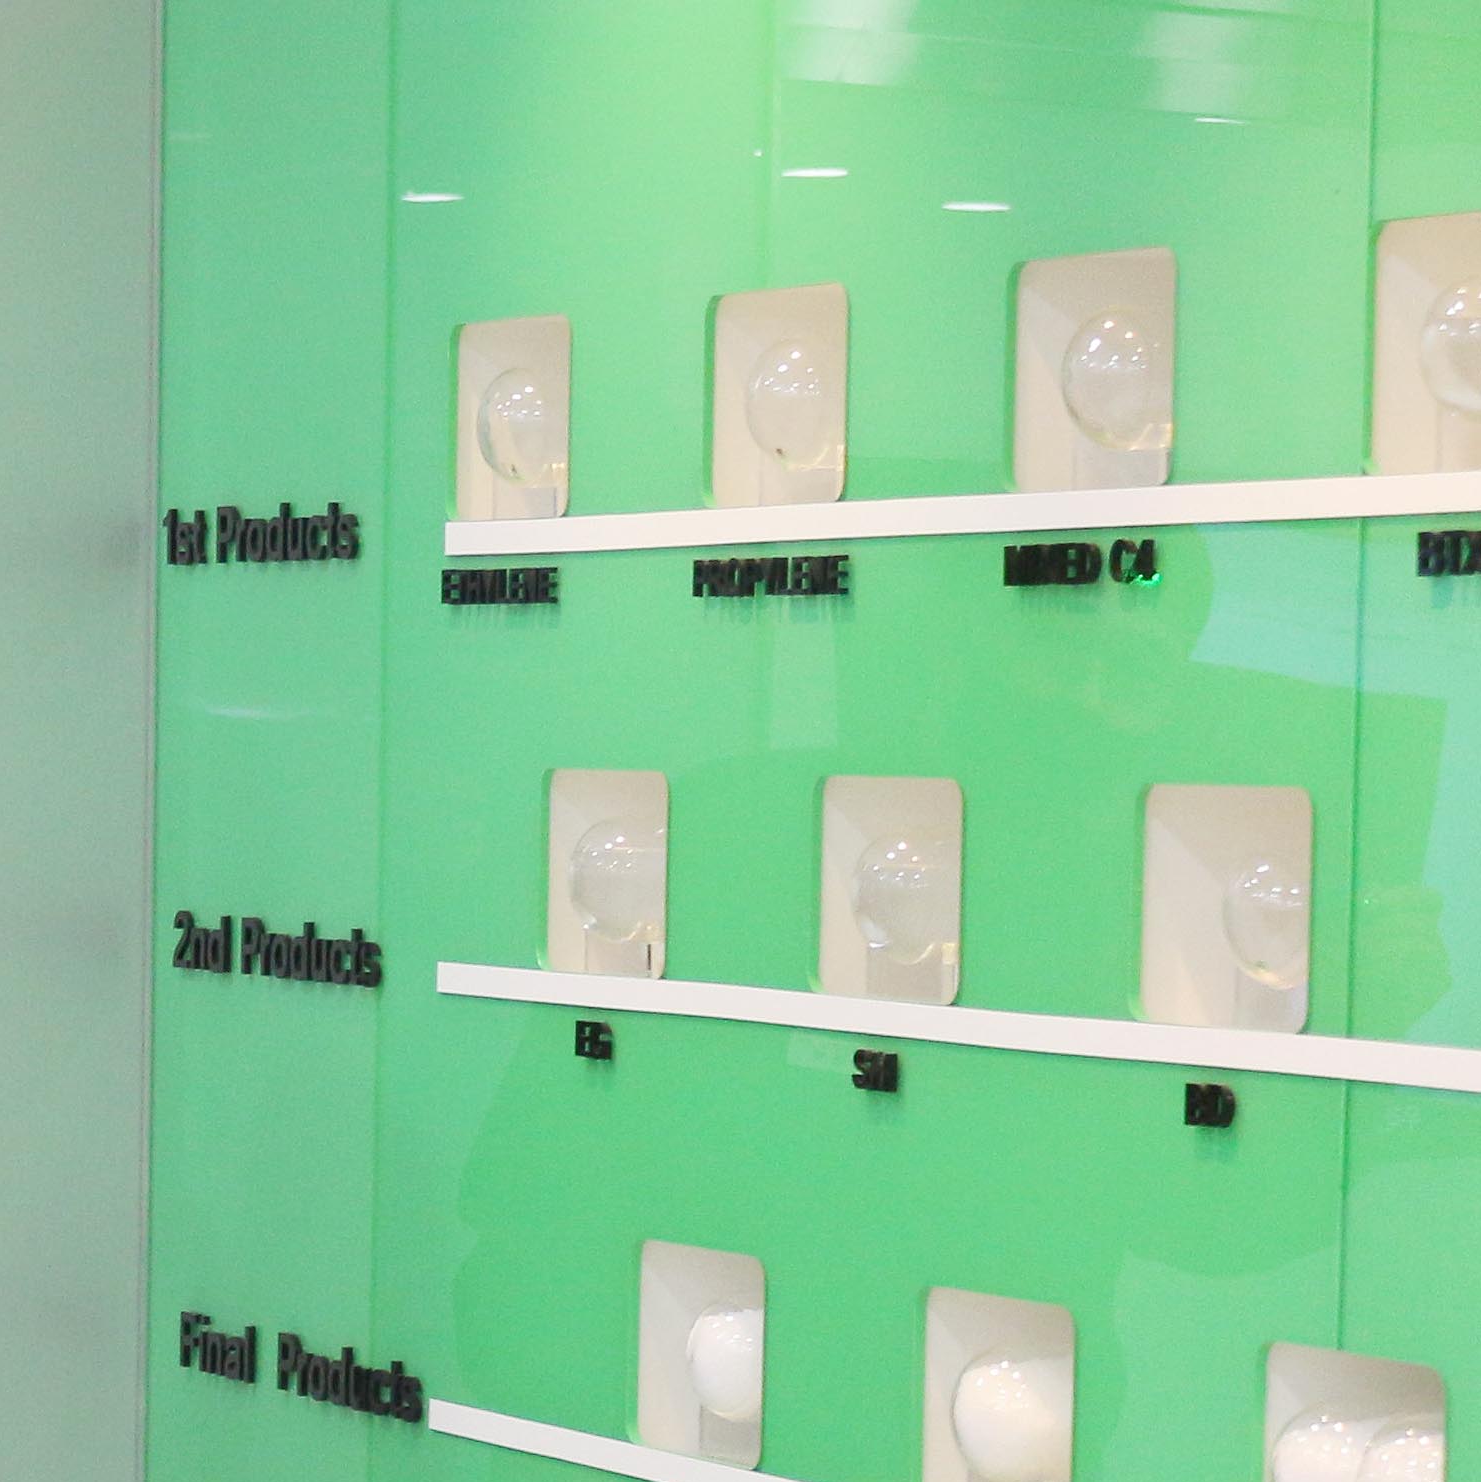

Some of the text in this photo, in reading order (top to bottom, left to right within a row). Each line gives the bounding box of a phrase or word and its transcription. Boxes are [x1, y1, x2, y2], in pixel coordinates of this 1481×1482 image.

[163, 502, 360, 565] 1st Products
[173, 910, 382, 987] 2nd Products
[180, 1311, 423, 1422] Final Products
